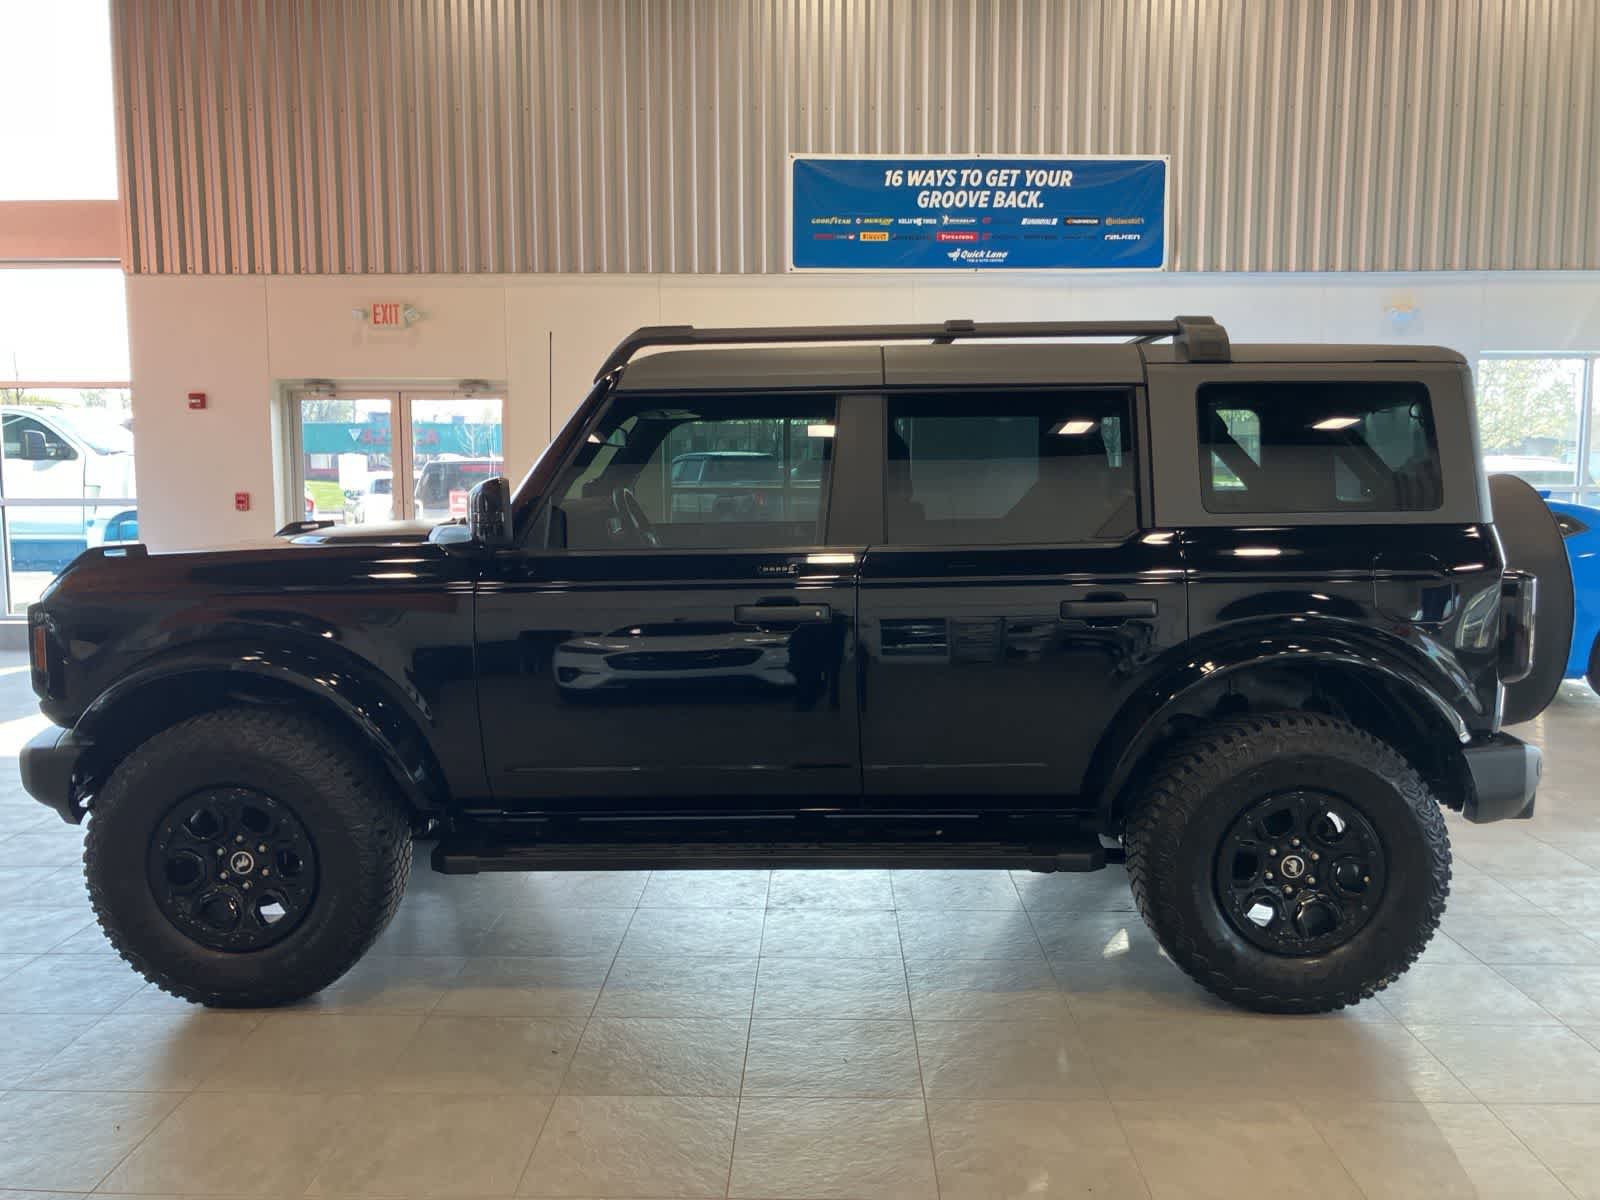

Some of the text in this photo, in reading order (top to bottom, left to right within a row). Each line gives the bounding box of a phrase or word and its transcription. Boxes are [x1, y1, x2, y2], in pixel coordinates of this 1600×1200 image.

[884, 169, 1073, 187] 16 WAYS TO GET YOUR
[917, 190, 1045, 208] GROOVE BACK.
[960, 249, 1009, 260] Quick Lane
[372, 303, 401, 325] EXIT
